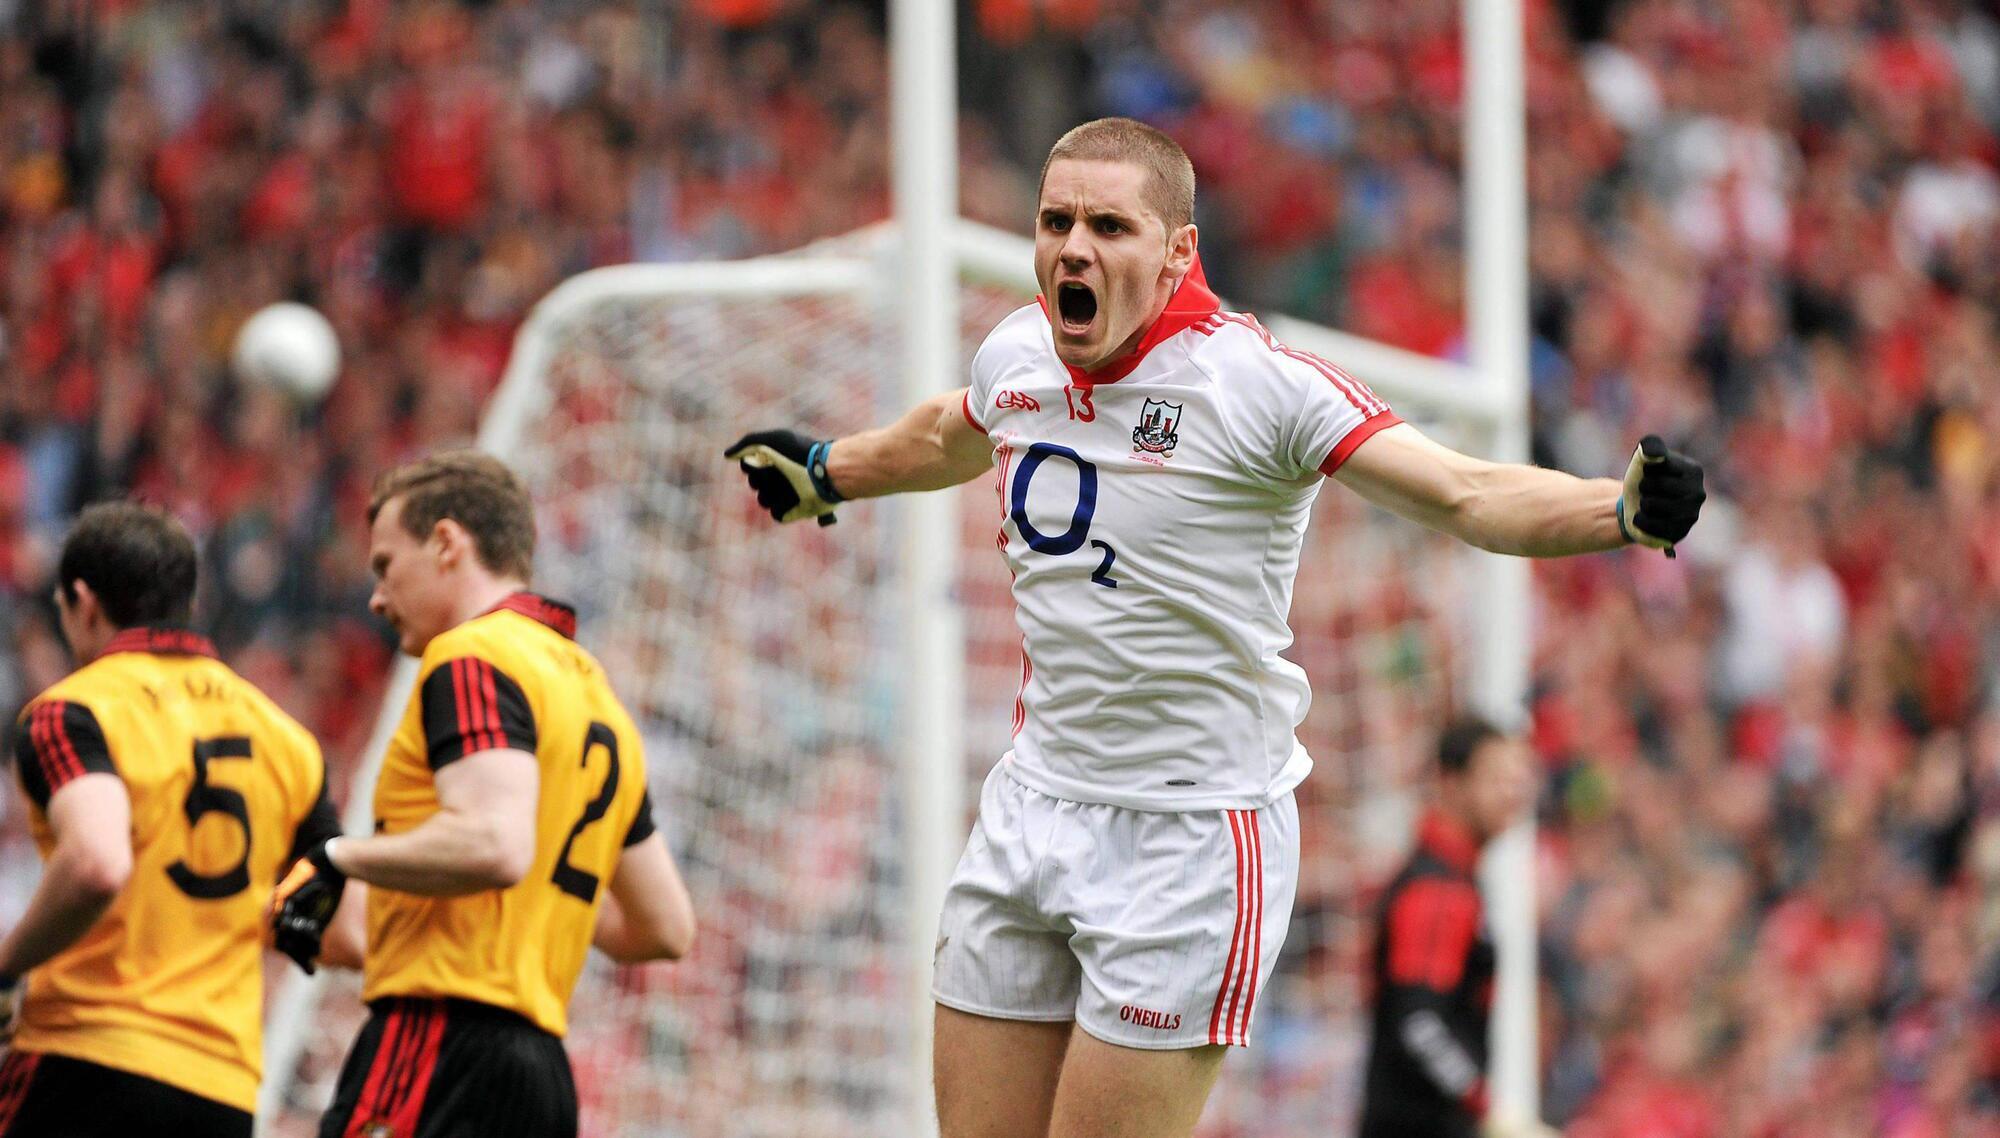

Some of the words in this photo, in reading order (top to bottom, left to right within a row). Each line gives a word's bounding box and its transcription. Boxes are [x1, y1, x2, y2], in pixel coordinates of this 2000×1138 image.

[1063, 384, 1096, 423] 13
[165, 736, 253, 900] 5
[551, 722, 620, 904] 2
[1120, 1005, 1181, 1030] O'NEILLS
